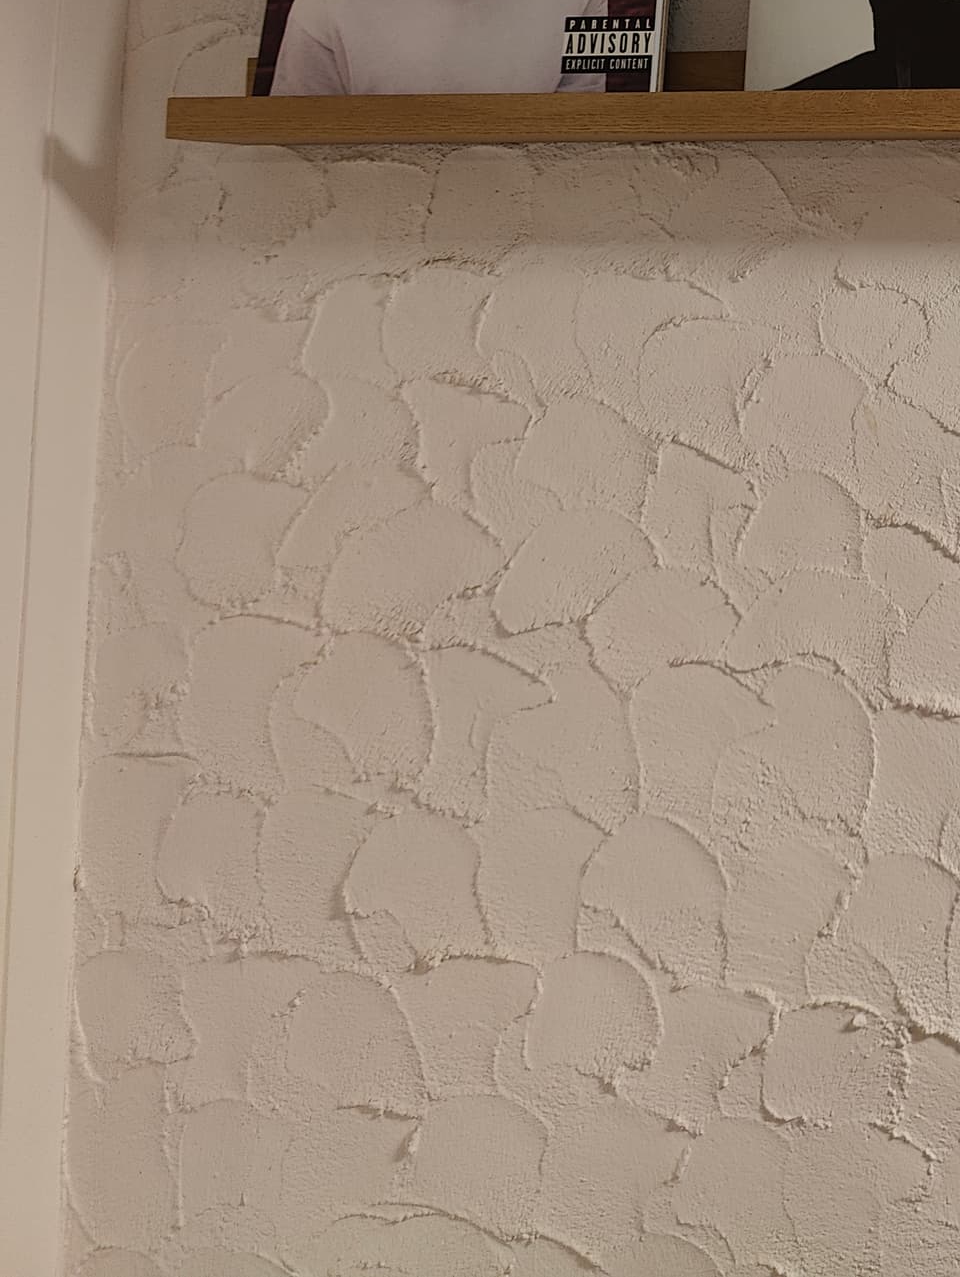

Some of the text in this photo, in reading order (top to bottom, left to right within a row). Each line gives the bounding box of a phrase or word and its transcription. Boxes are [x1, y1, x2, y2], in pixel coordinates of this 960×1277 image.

[569, 18, 651, 30] PARENTAL
[565, 32, 651, 54] ADVISORY
[565, 57, 649, 70] EXPLICIT CONTENT
